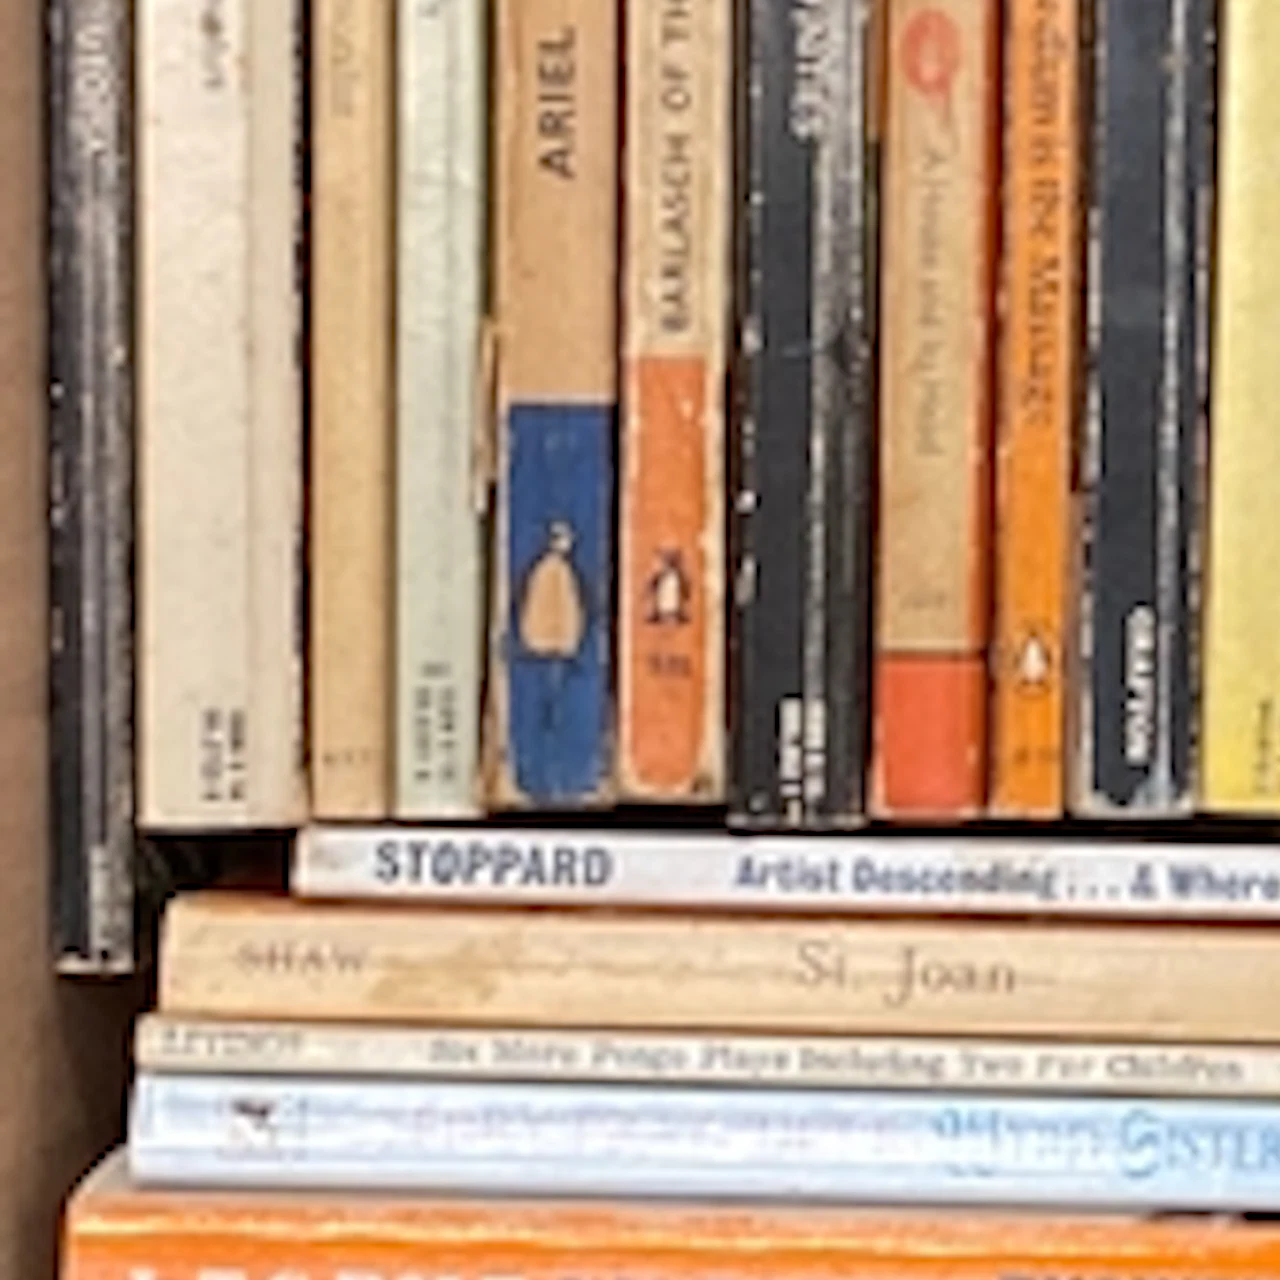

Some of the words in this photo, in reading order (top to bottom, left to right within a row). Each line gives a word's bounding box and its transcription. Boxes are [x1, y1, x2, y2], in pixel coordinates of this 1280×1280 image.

[537, 25, 577, 181] ARIEL
[659, 64, 692, 114] OF
[659, 131, 692, 333] BARLASCH
[1125, 604, 1155, 767] GRAFTON
[374, 839, 614, 888] STOPPARD
[732, 855, 839, 888] Artist
[1129, 864, 1154, 899] &
[237, 940, 369, 974] SHAW
[881, 944, 1019, 1011] Joan
[1103, 1054, 1246, 1082] Children
